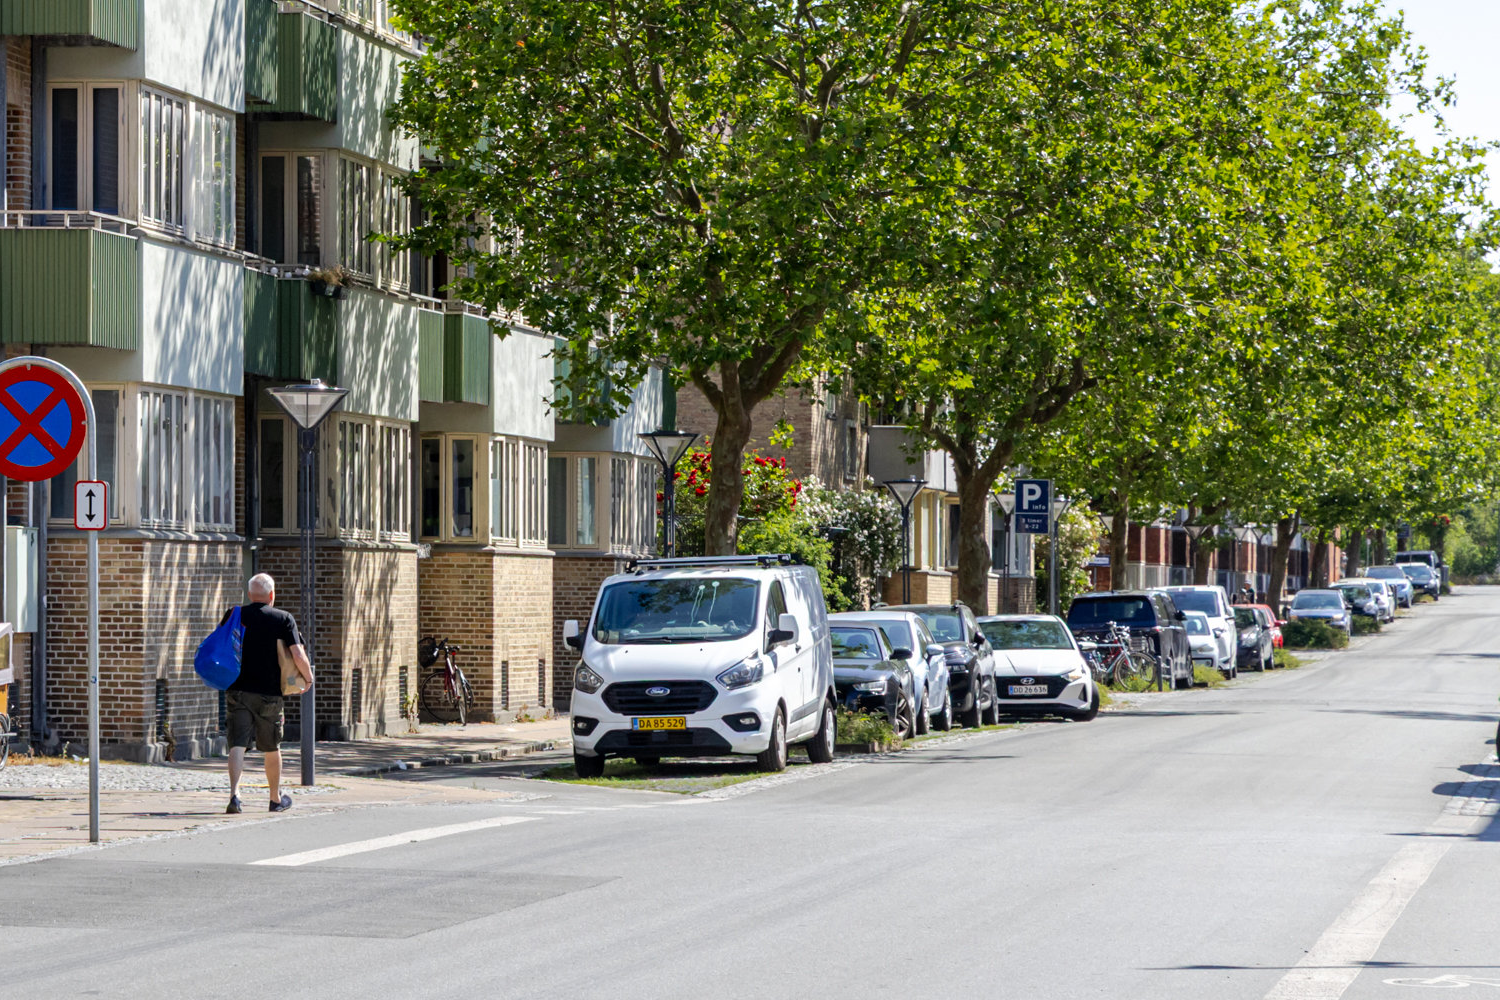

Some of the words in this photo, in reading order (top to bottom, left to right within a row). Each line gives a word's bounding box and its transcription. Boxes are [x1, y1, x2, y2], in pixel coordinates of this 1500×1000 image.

[1022, 483, 1042, 510] P
[650, 687, 667, 695] Ford
[639, 719, 652, 728] DA
[653, 719, 665, 728] 85
[667, 718, 684, 728] 529
